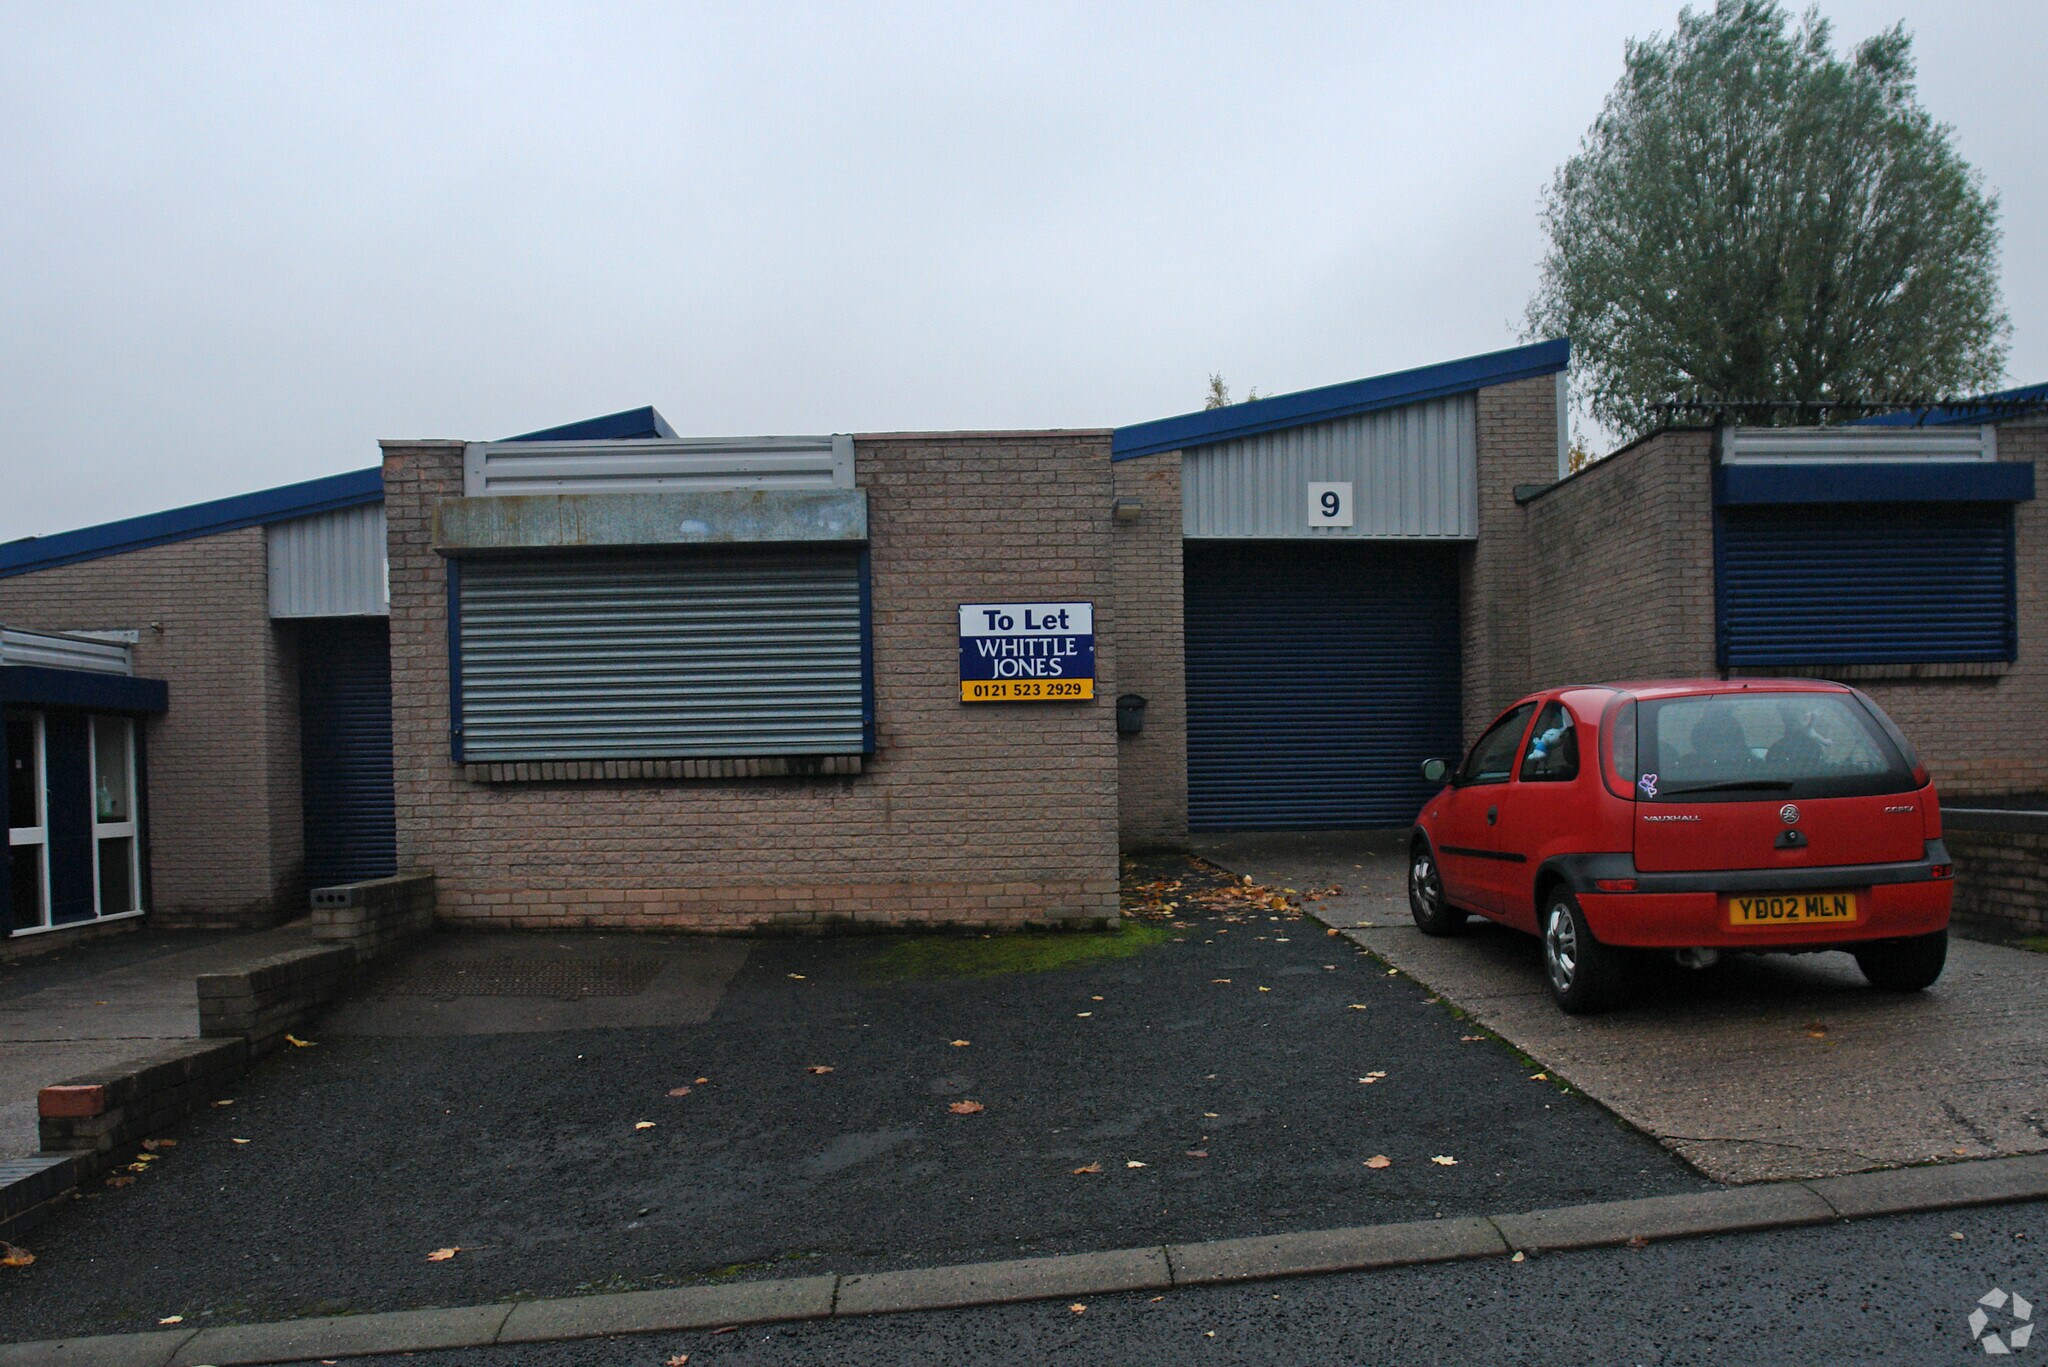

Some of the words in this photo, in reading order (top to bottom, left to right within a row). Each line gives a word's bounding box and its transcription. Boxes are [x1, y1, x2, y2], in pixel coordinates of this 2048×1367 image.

[1320, 490, 1340, 518] 9
[982, 609, 1014, 631] To
[1024, 608, 1070, 630] Let
[975, 637, 1078, 657] WHITTLE
[992, 657, 1063, 679] JONES
[973, 684, 1007, 697] 0121
[1013, 683, 1041, 696] 523
[1046, 683, 1082, 696] 2929
[1643, 814, 1702, 823] VAUXHALL
[1739, 898, 1799, 920] YD02
[1805, 895, 1847, 917] MLN
